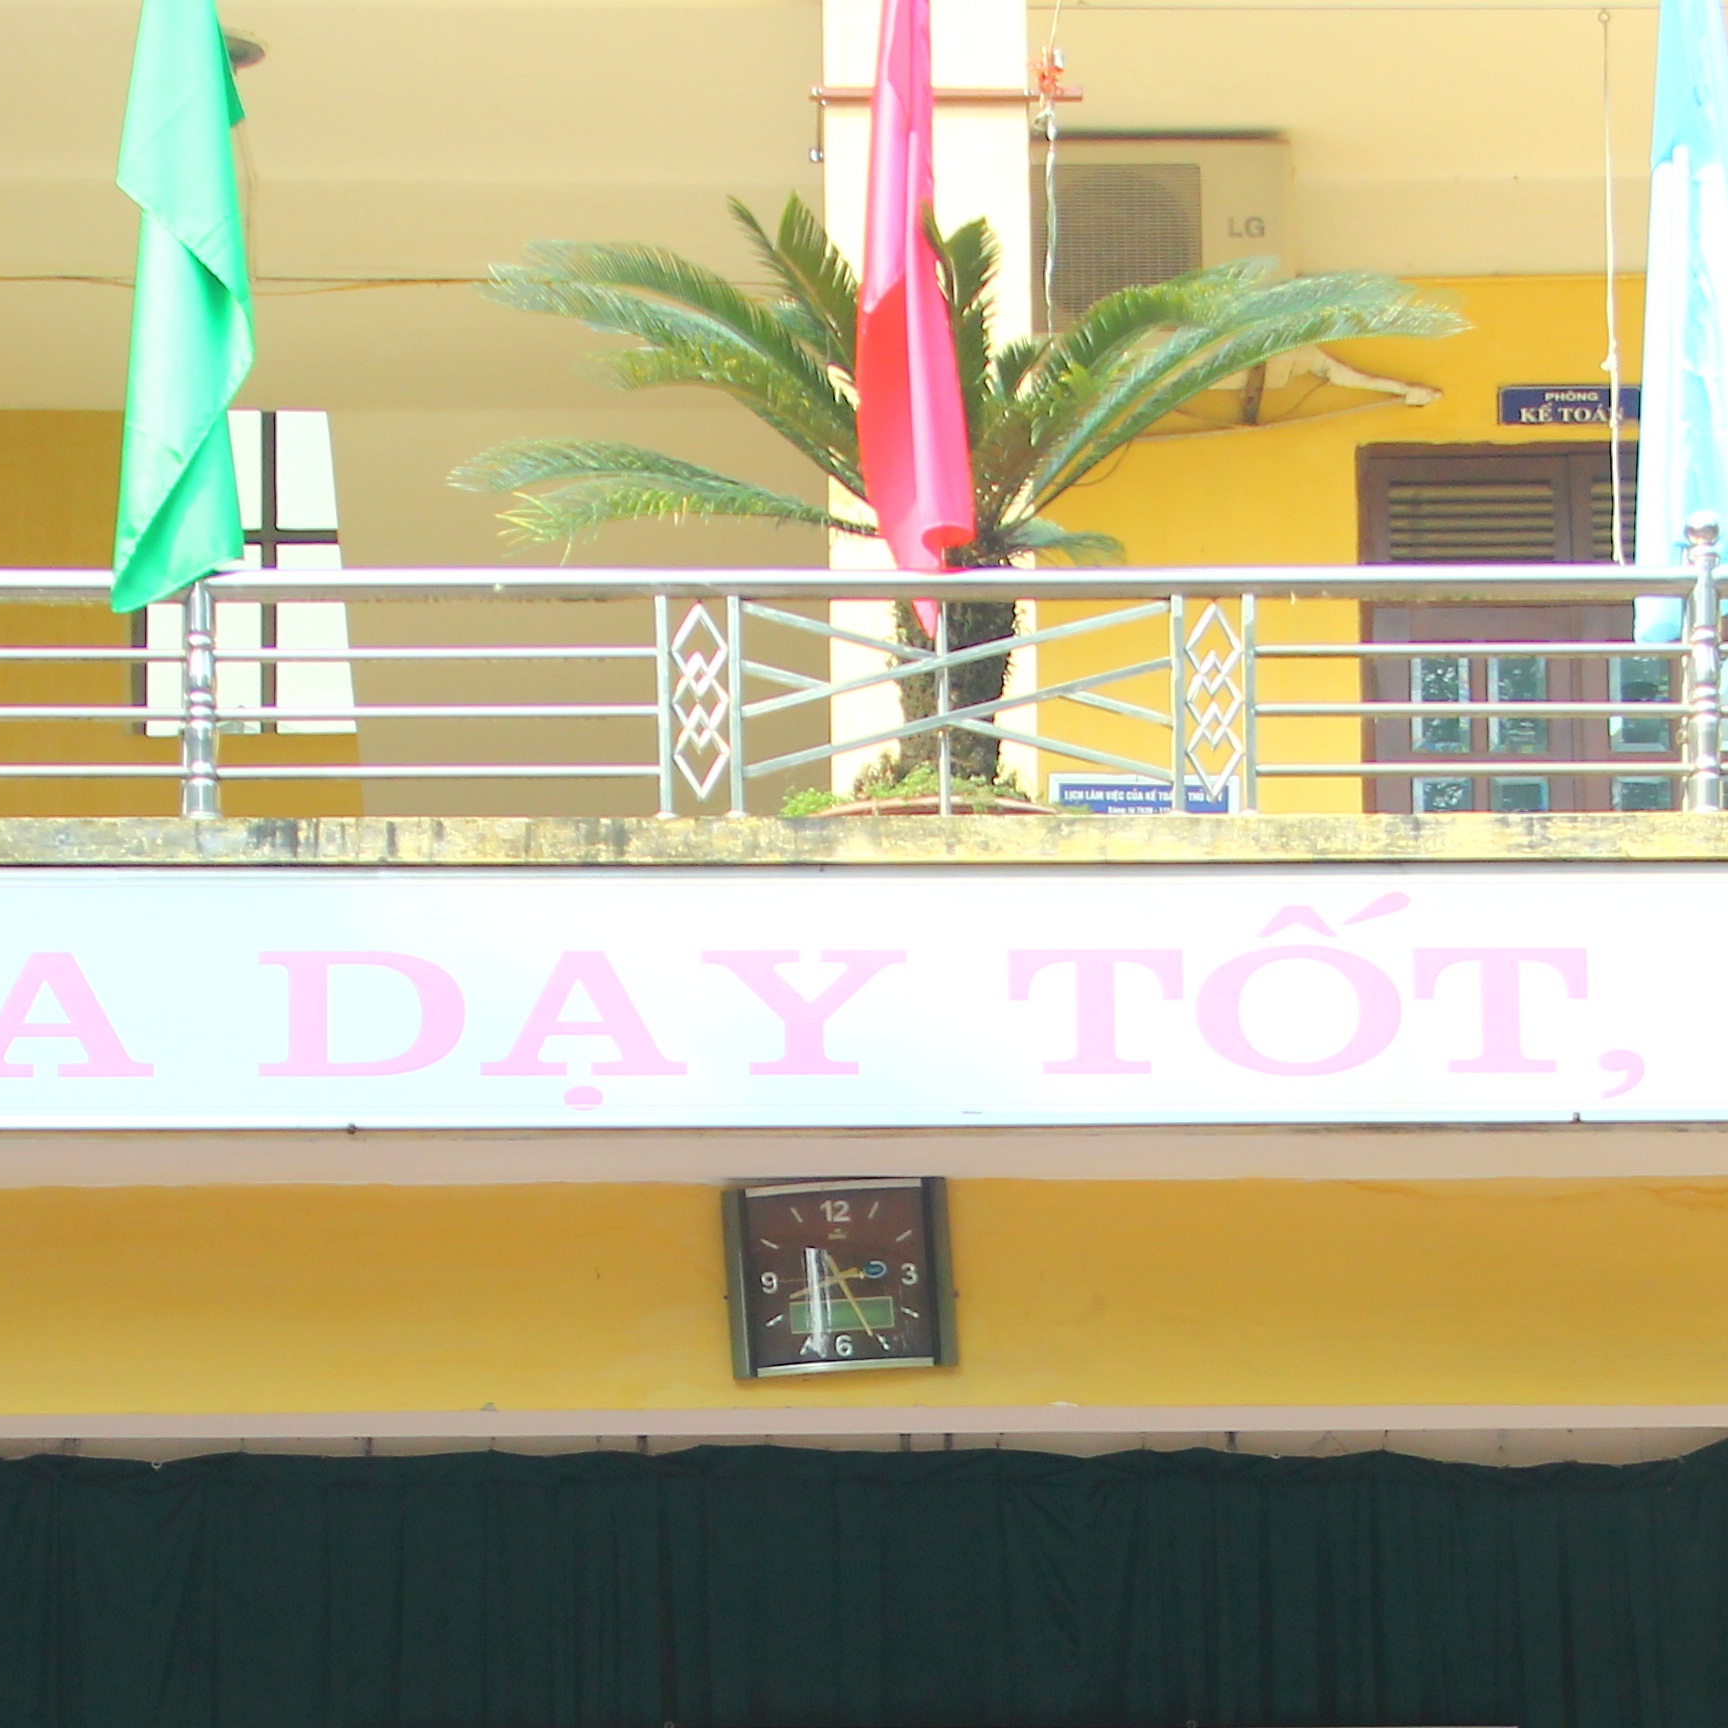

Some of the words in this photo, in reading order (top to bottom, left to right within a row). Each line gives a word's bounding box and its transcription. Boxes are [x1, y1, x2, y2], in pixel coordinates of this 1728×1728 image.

[1227, 216, 1265, 238] LG
[1544, 390, 1599, 402] PHÒNG
[1520, 402, 1553, 423] KẾ
[258, 948, 908, 1112] DẠY
[1007, 890, 1646, 1100] TỐT,
[819, 1200, 851, 1222] 12
[760, 1271, 779, 1295] 9
[900, 1262, 919, 1286] 3
[834, 1334, 854, 1357] 6
